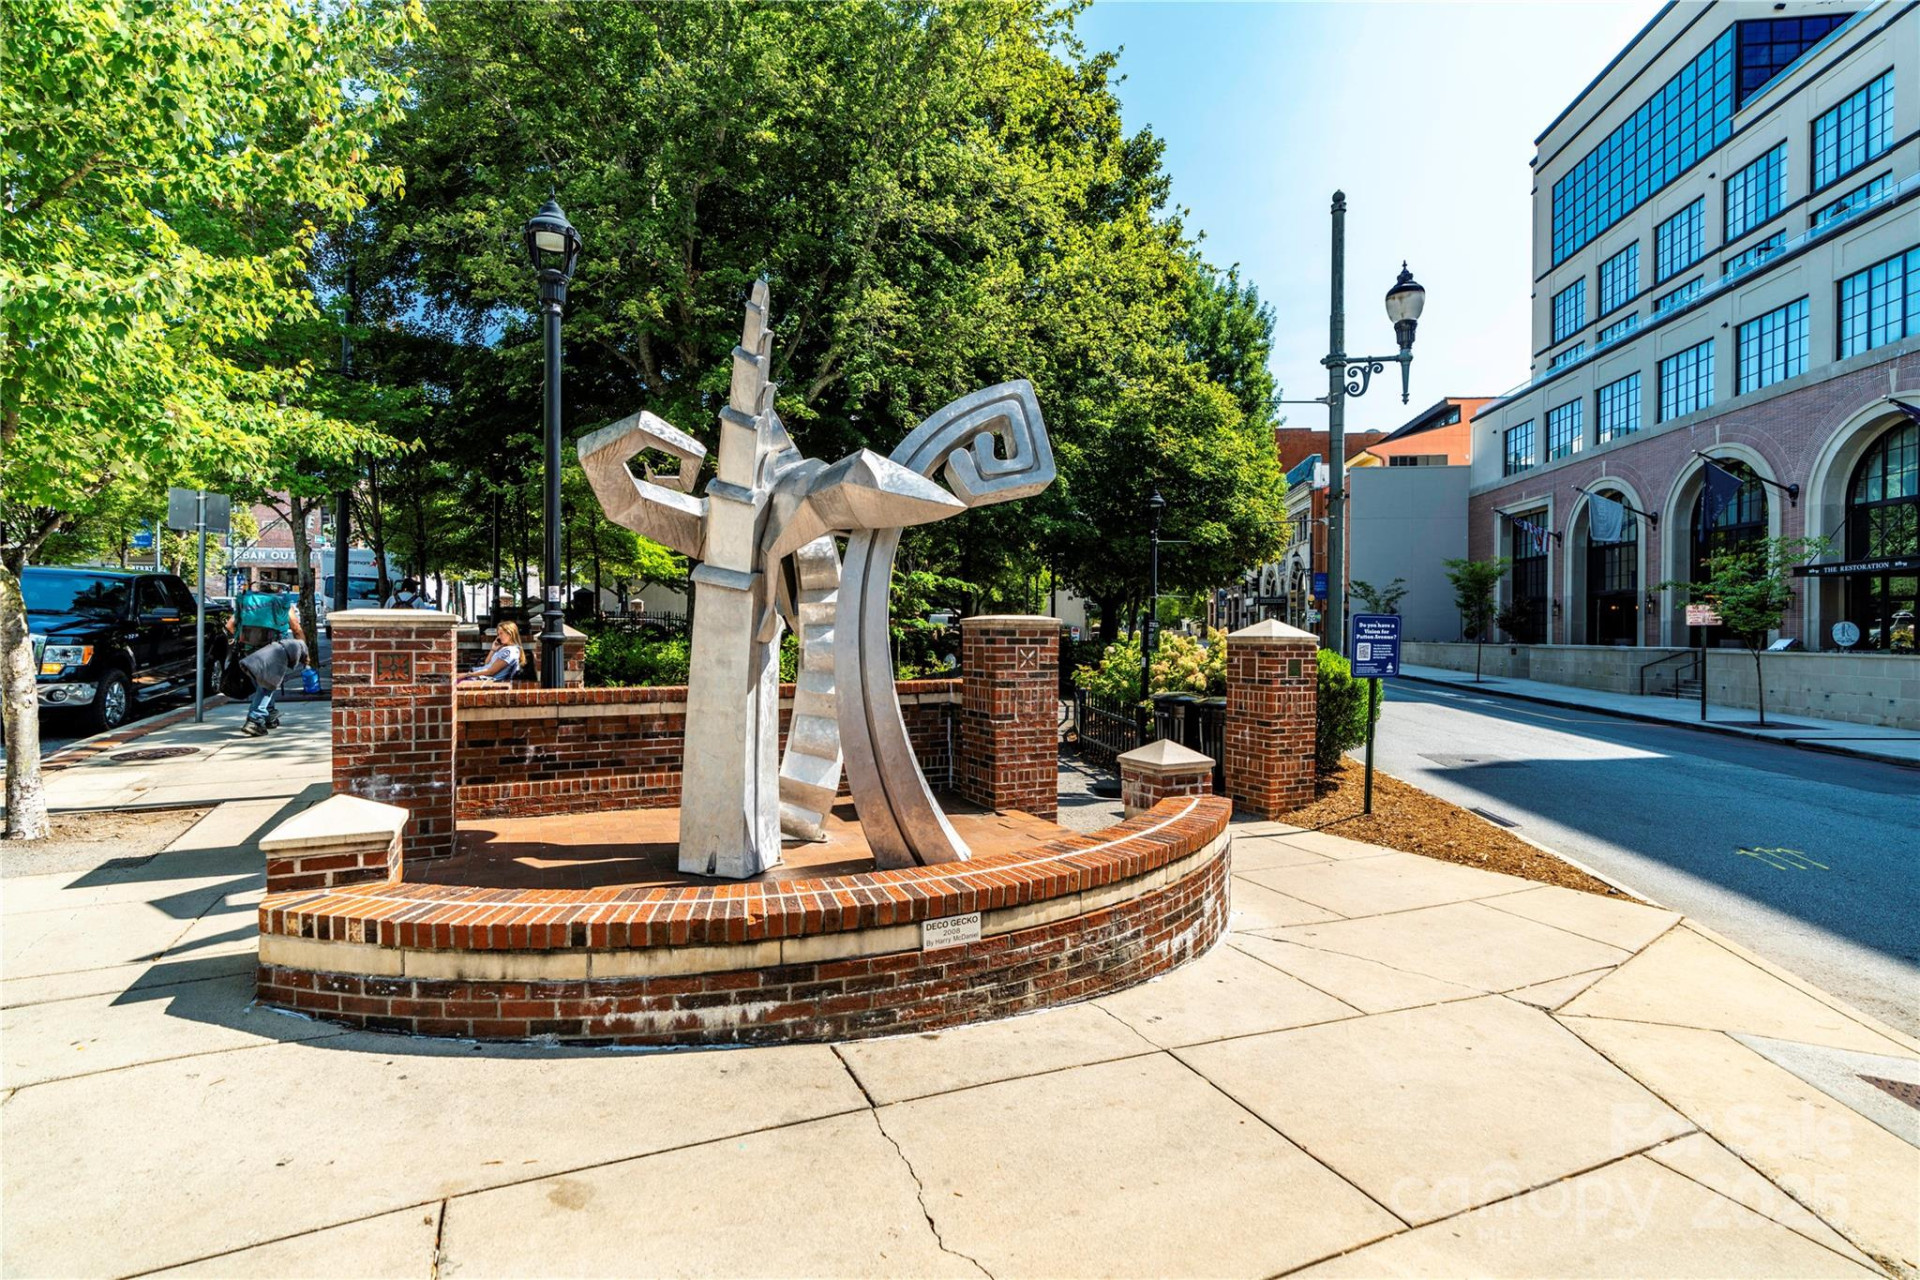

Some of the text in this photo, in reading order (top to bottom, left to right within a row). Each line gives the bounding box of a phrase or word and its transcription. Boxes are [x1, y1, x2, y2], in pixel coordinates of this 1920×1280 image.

[1824, 561, 1890, 574] THE RESTORATION
[926, 915, 979, 931] DECO GECKO
[943, 928, 961, 936] 2008
[926, 932, 979, 948] By Harry McDaniel
